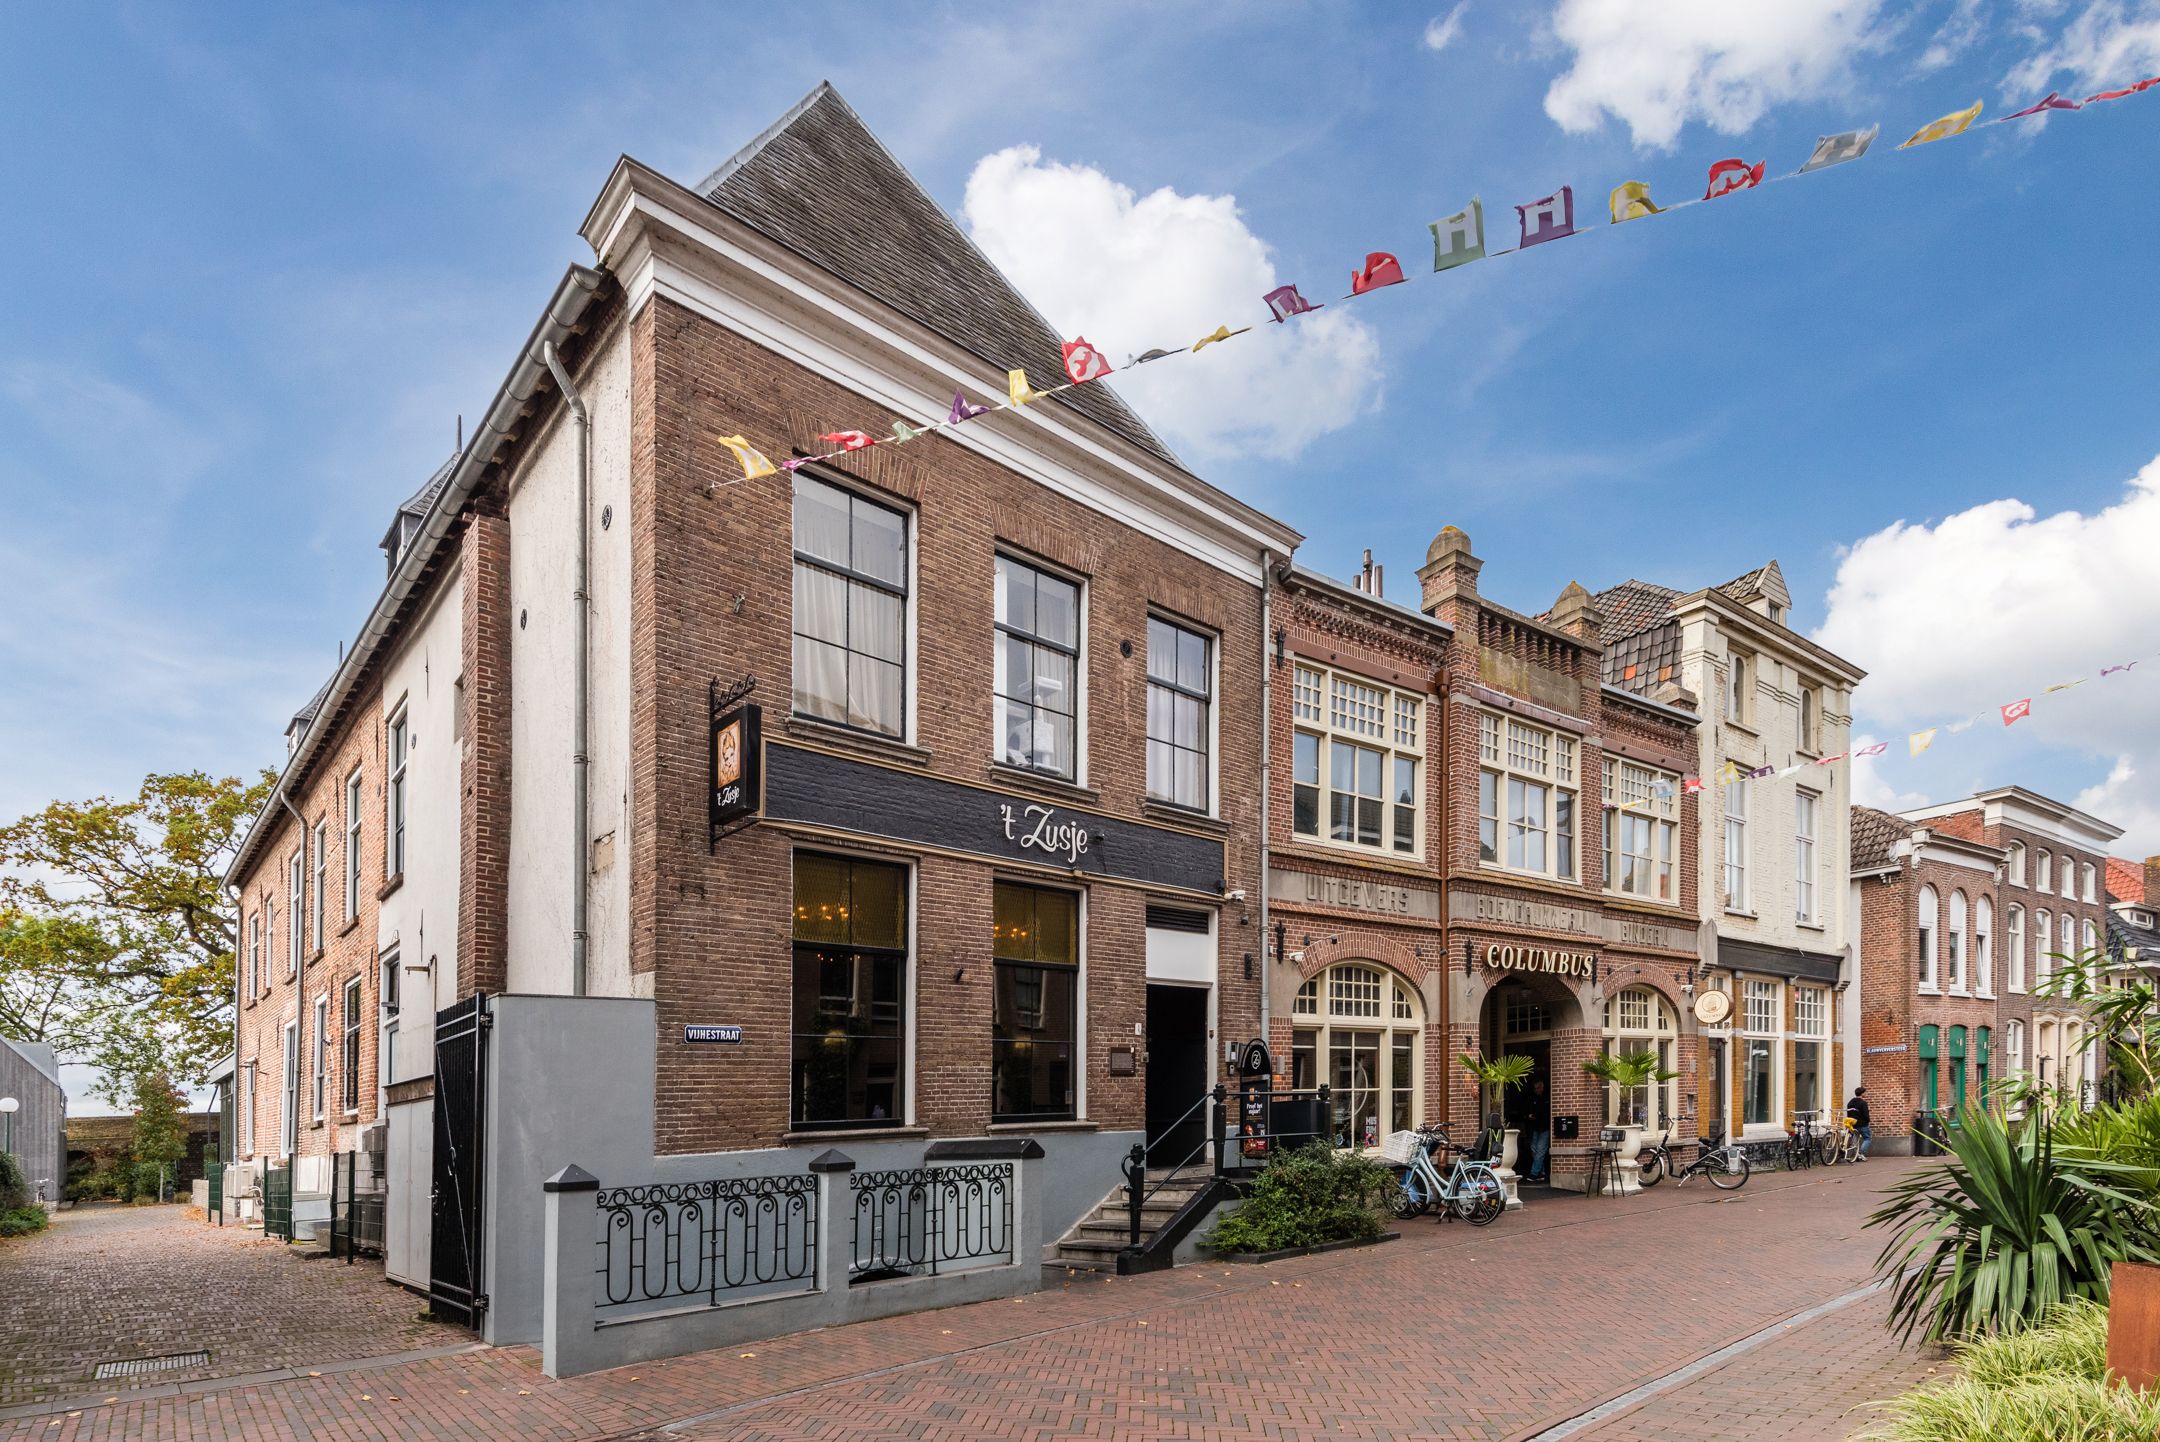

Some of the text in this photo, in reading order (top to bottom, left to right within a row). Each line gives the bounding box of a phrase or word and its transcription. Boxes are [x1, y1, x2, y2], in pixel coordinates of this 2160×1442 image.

[721, 785, 740, 807] Zusje
[1000, 803, 1088, 864] 't Zusje
[1306, 876, 1409, 913] UITGEVERS
[1477, 895, 1587, 933] BOEKDRUKKERIJ
[1620, 922, 1670, 948] BINDERIJ
[1487, 944, 1595, 978] COLUMBUS
[688, 1029, 741, 1041] VIJHESTRAAT
